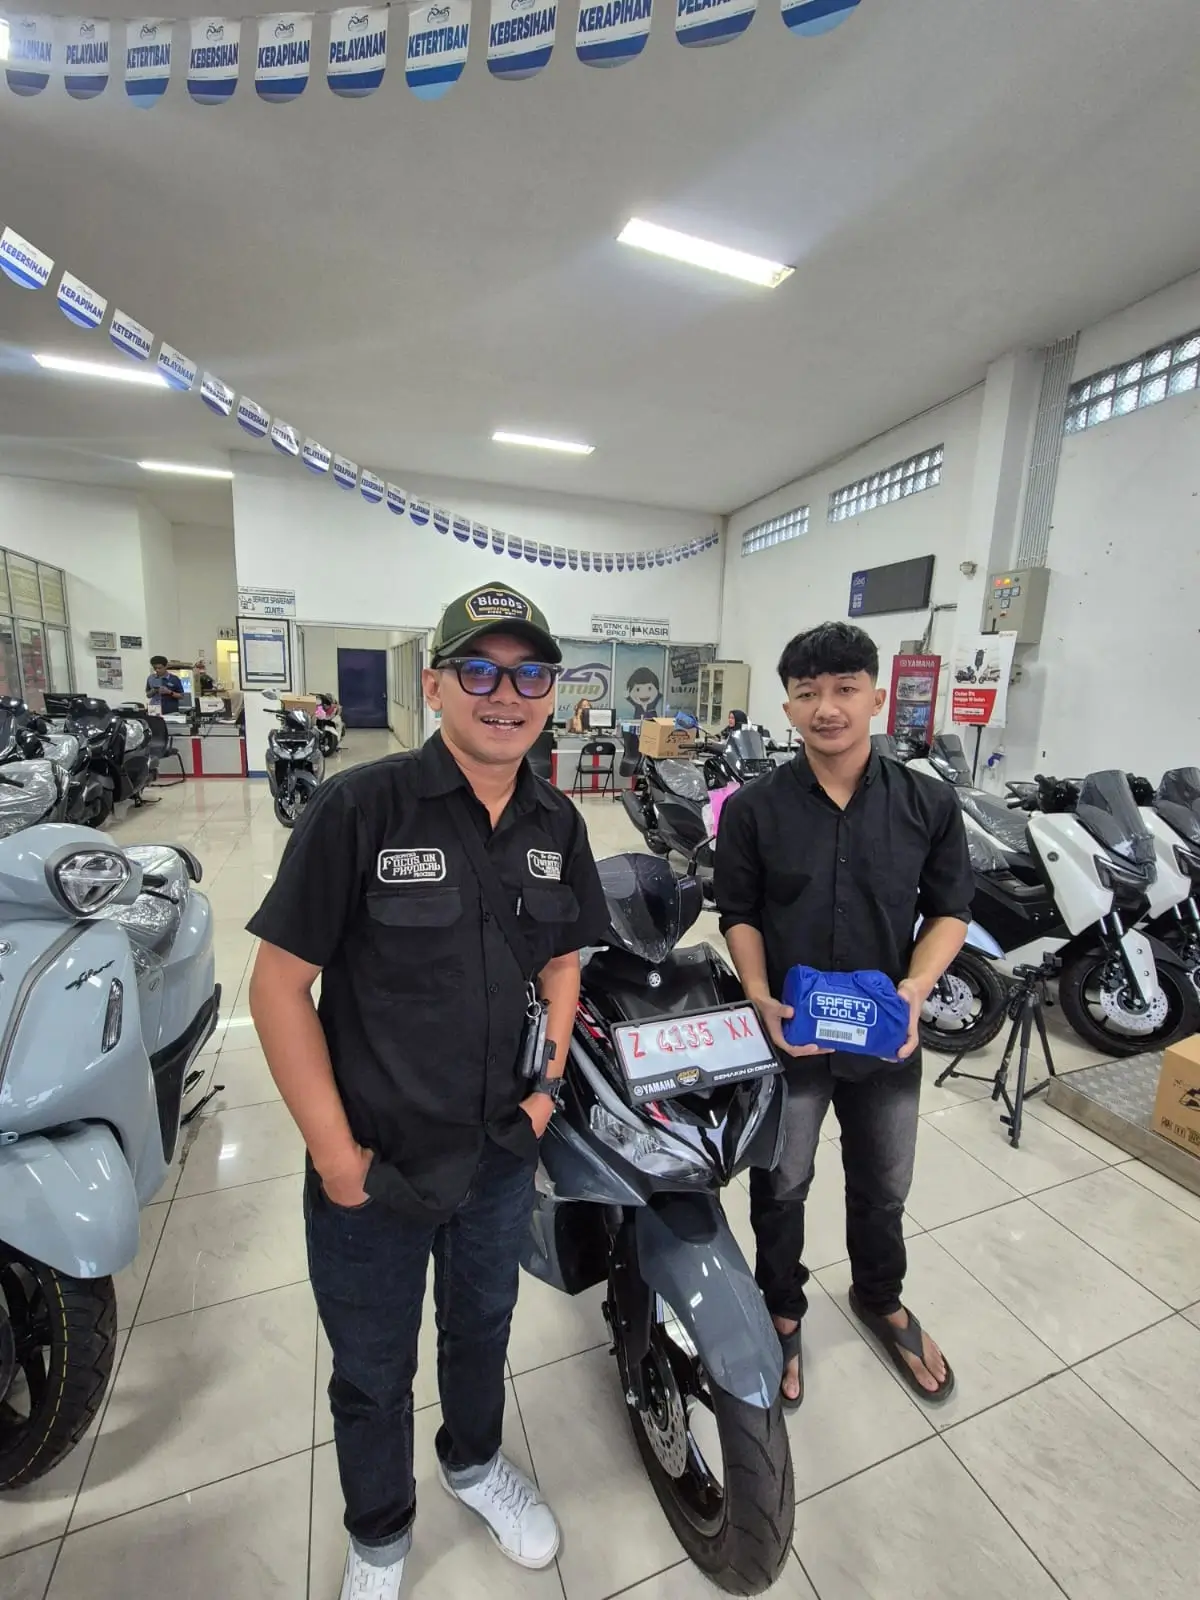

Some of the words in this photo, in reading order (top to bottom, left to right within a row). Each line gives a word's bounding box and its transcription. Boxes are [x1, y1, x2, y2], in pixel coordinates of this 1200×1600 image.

[578, 0, 652, 32] KERAPIHAN
[328, 31, 387, 62] PELAYANAN
[407, 23, 469, 59] KETERTIBAN
[489, 17, 556, 47] KEBERSIHAN
[66, 41, 109, 65] PELAYANAN
[126, 43, 171, 69] KETERTIBAN
[190, 42, 239, 69] KEBERSIHAN
[257, 40, 311, 69] KERAPIHAN
[0, 239, 49, 280] KEBERSIHAN
[60, 283, 104, 319] KERAPIHAN
[112, 320, 150, 353] KETERTIBAN
[159, 353, 195, 382] PELAYANAN
[642, 626, 669, 636] KASIR
[907, 659, 936, 669] YAMAHA
[816, 995, 871, 1012] SAFETY
[821, 1006, 866, 1022] TOOLS
[627, 1032, 646, 1058] Z
[657, 1021, 714, 1052] 4135
[724, 1015, 754, 1041] XX
[713, 1068, 747, 1081] SEMAKIN
[755, 1062, 778, 1072] DEPAN
[643, 1079, 677, 1095] YAMAHA
